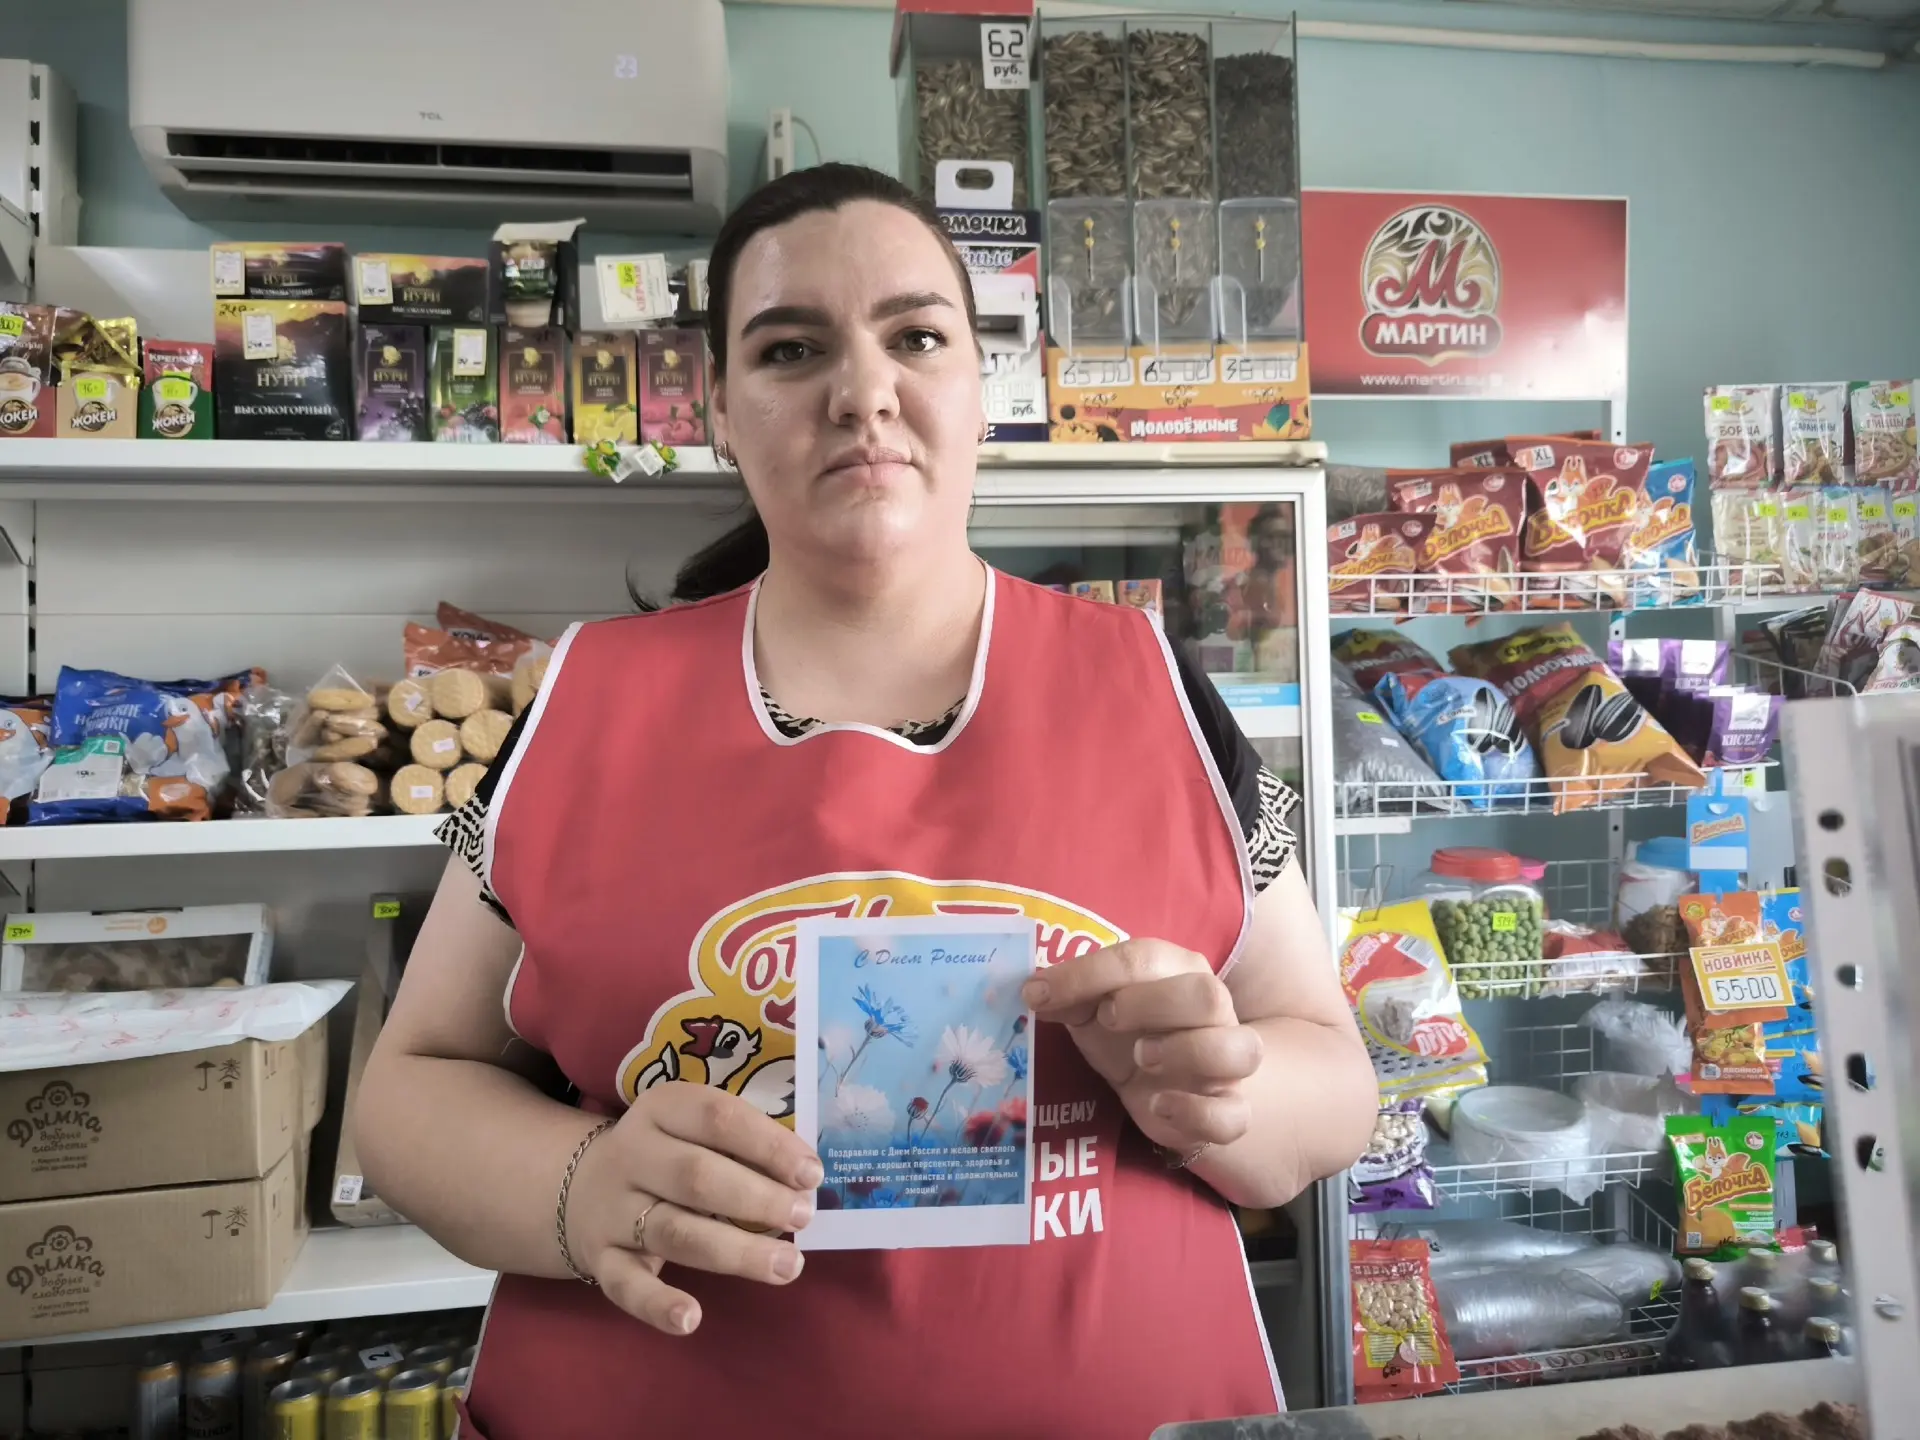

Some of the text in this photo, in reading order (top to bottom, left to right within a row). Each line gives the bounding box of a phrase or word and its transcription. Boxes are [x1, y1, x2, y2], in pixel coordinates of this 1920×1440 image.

[988, 29, 1023, 58] 62
[993, 64, 1022, 78] руб.
[418, 110, 444, 121] TCL
[939, 213, 1027, 235] емечки
[1375, 320, 1488, 346] МАРТИН
[1012, 404, 1037, 417] руб.
[1130, 415, 1239, 438] МОЛОДЁЖНЫЕ
[853, 947, 998, 969] С Днем России!
[1703, 949, 1774, 973] НОВИНКА
[1033, 1099, 1097, 1130] ЩЕМУ
[828, 1145, 1016, 1159] Поздравляю с Днем России и желаю светлого
[1031, 1135, 1099, 1183] ЫЕ
[877, 1161, 912, 1171] хороших
[965, 1158, 1003, 1168] здоровья
[947, 1173, 953, 1181] и
[954, 1171, 1019, 1181] положительных
[904, 1184, 939, 1195] эмоций!
